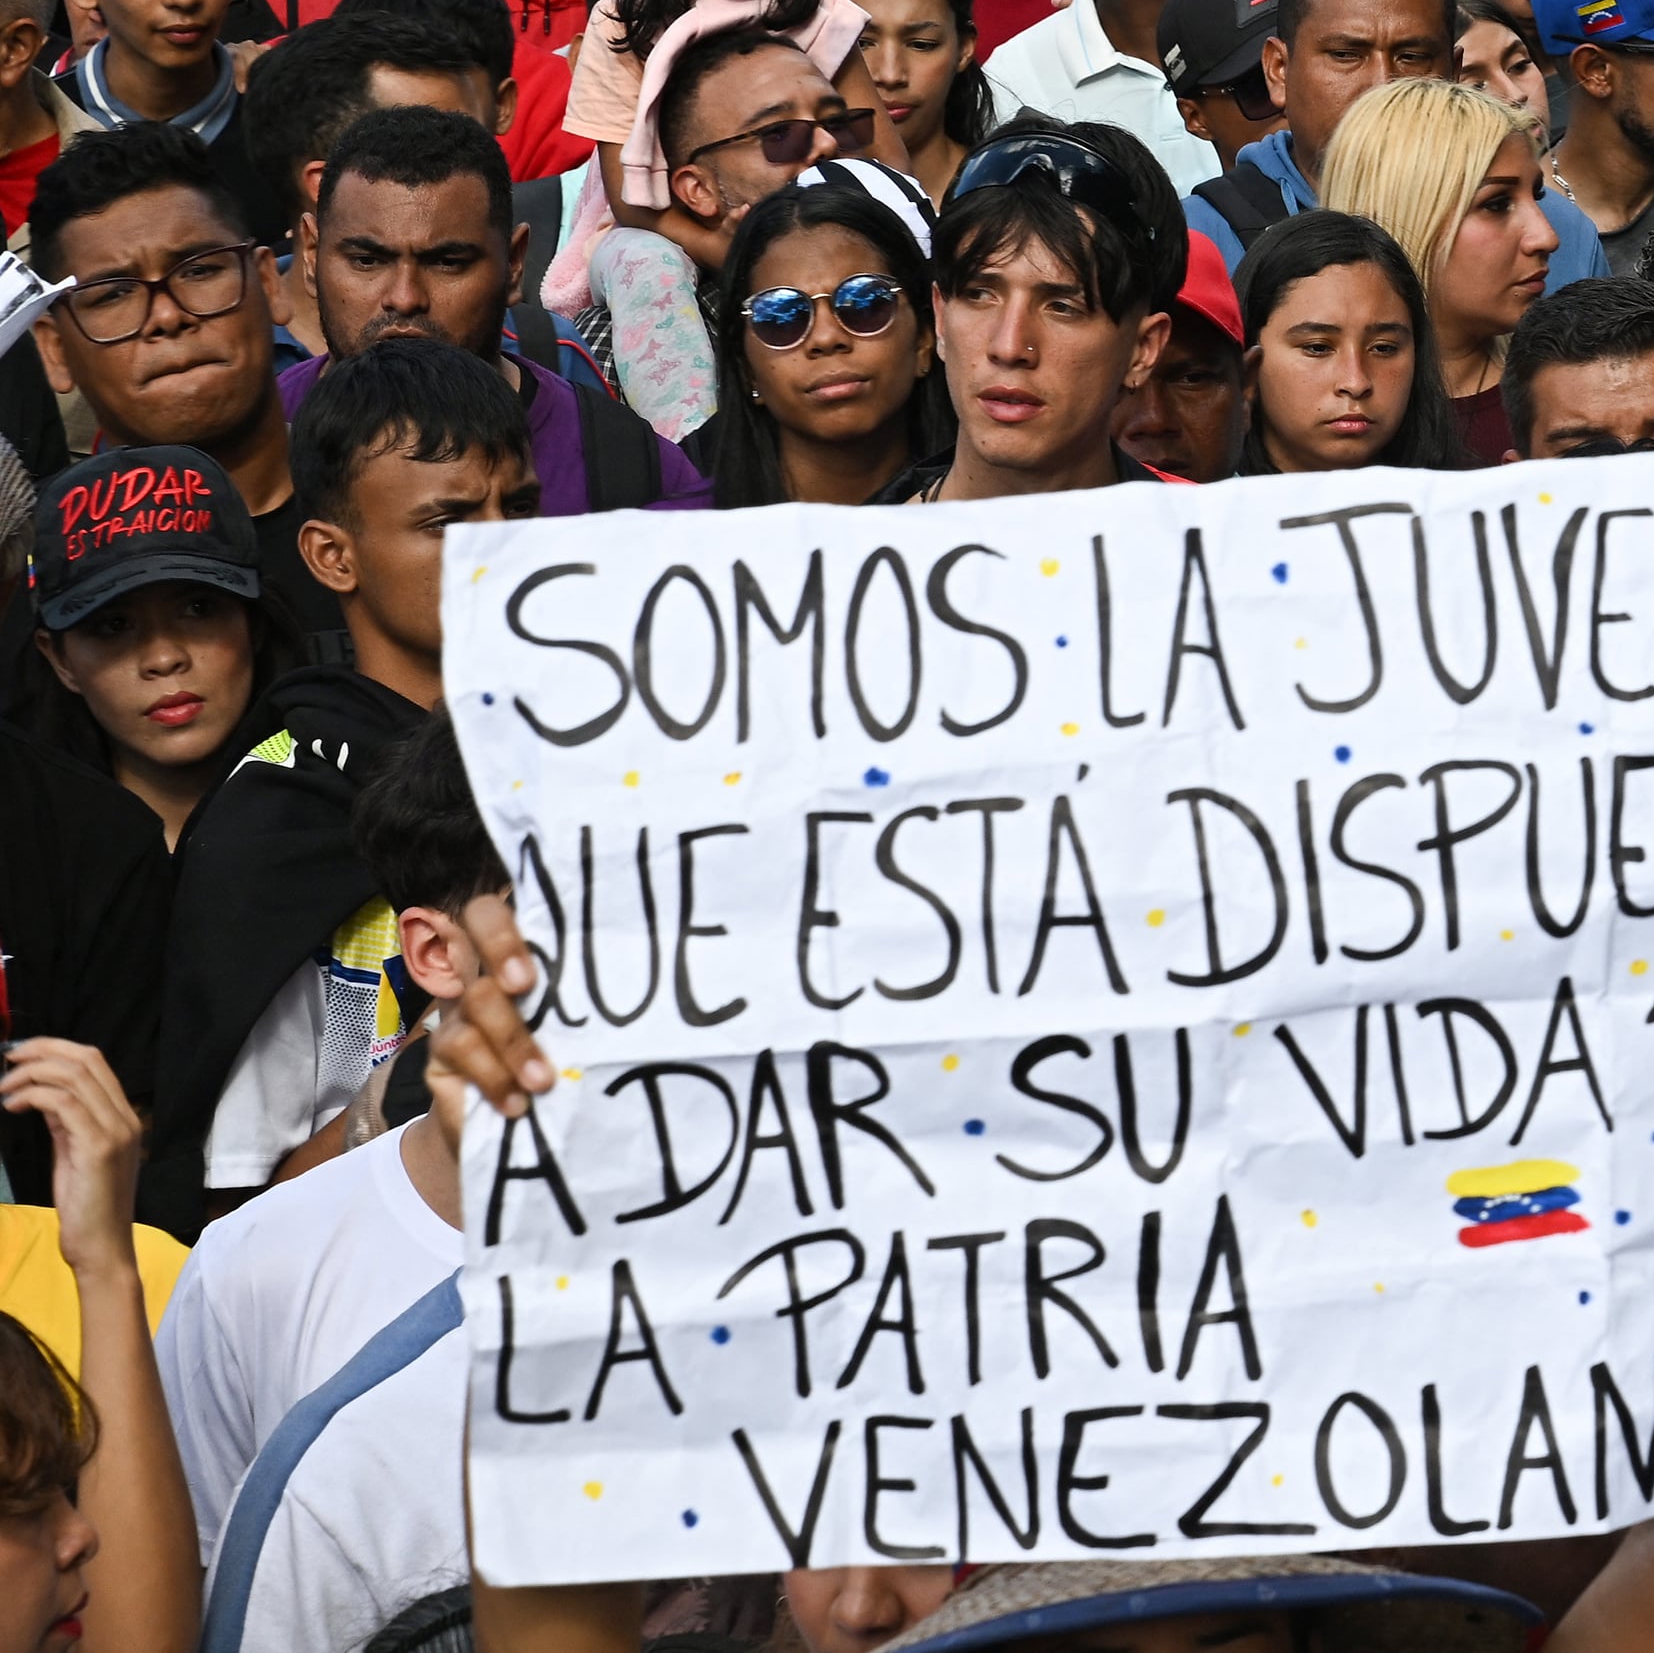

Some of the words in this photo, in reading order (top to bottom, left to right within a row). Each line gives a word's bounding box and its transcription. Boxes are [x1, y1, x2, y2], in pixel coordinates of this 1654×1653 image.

[60, 466, 213, 537] DUDAR
[66, 523, 91, 560] ES
[503, 544, 1029, 748] SOMOS
[1095, 528, 1245, 730] LA
[516, 824, 750, 1031] QUE
[794, 762, 1130, 1011] ESTÁ
[483, 1110, 588, 1244] A
[603, 1043, 935, 1226] DAR
[994, 1027, 1194, 1184] SU
[1275, 978, 1616, 1158] VIDA
[493, 1257, 684, 1424] LA
[717, 1194, 1262, 1399] PATRIA
